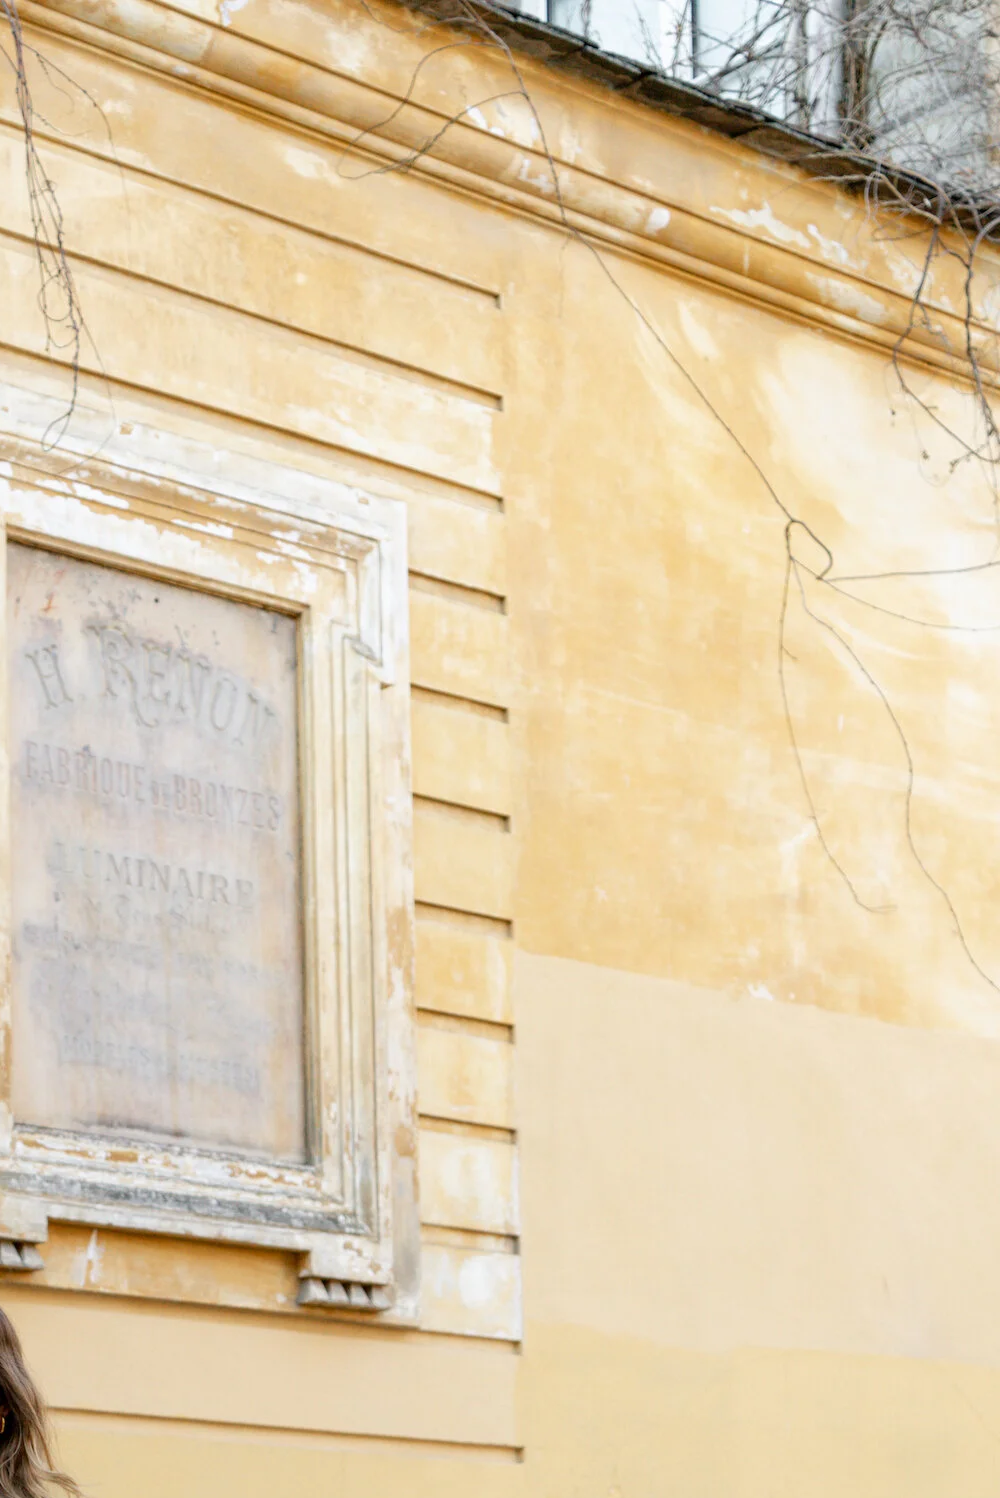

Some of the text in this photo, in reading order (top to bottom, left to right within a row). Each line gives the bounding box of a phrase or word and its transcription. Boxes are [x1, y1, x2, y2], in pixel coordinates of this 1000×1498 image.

[22, 739, 147, 804] FABRIQUE
[172, 773, 281, 832] BRONZES
[47, 839, 256, 913] LUMINAIRE
